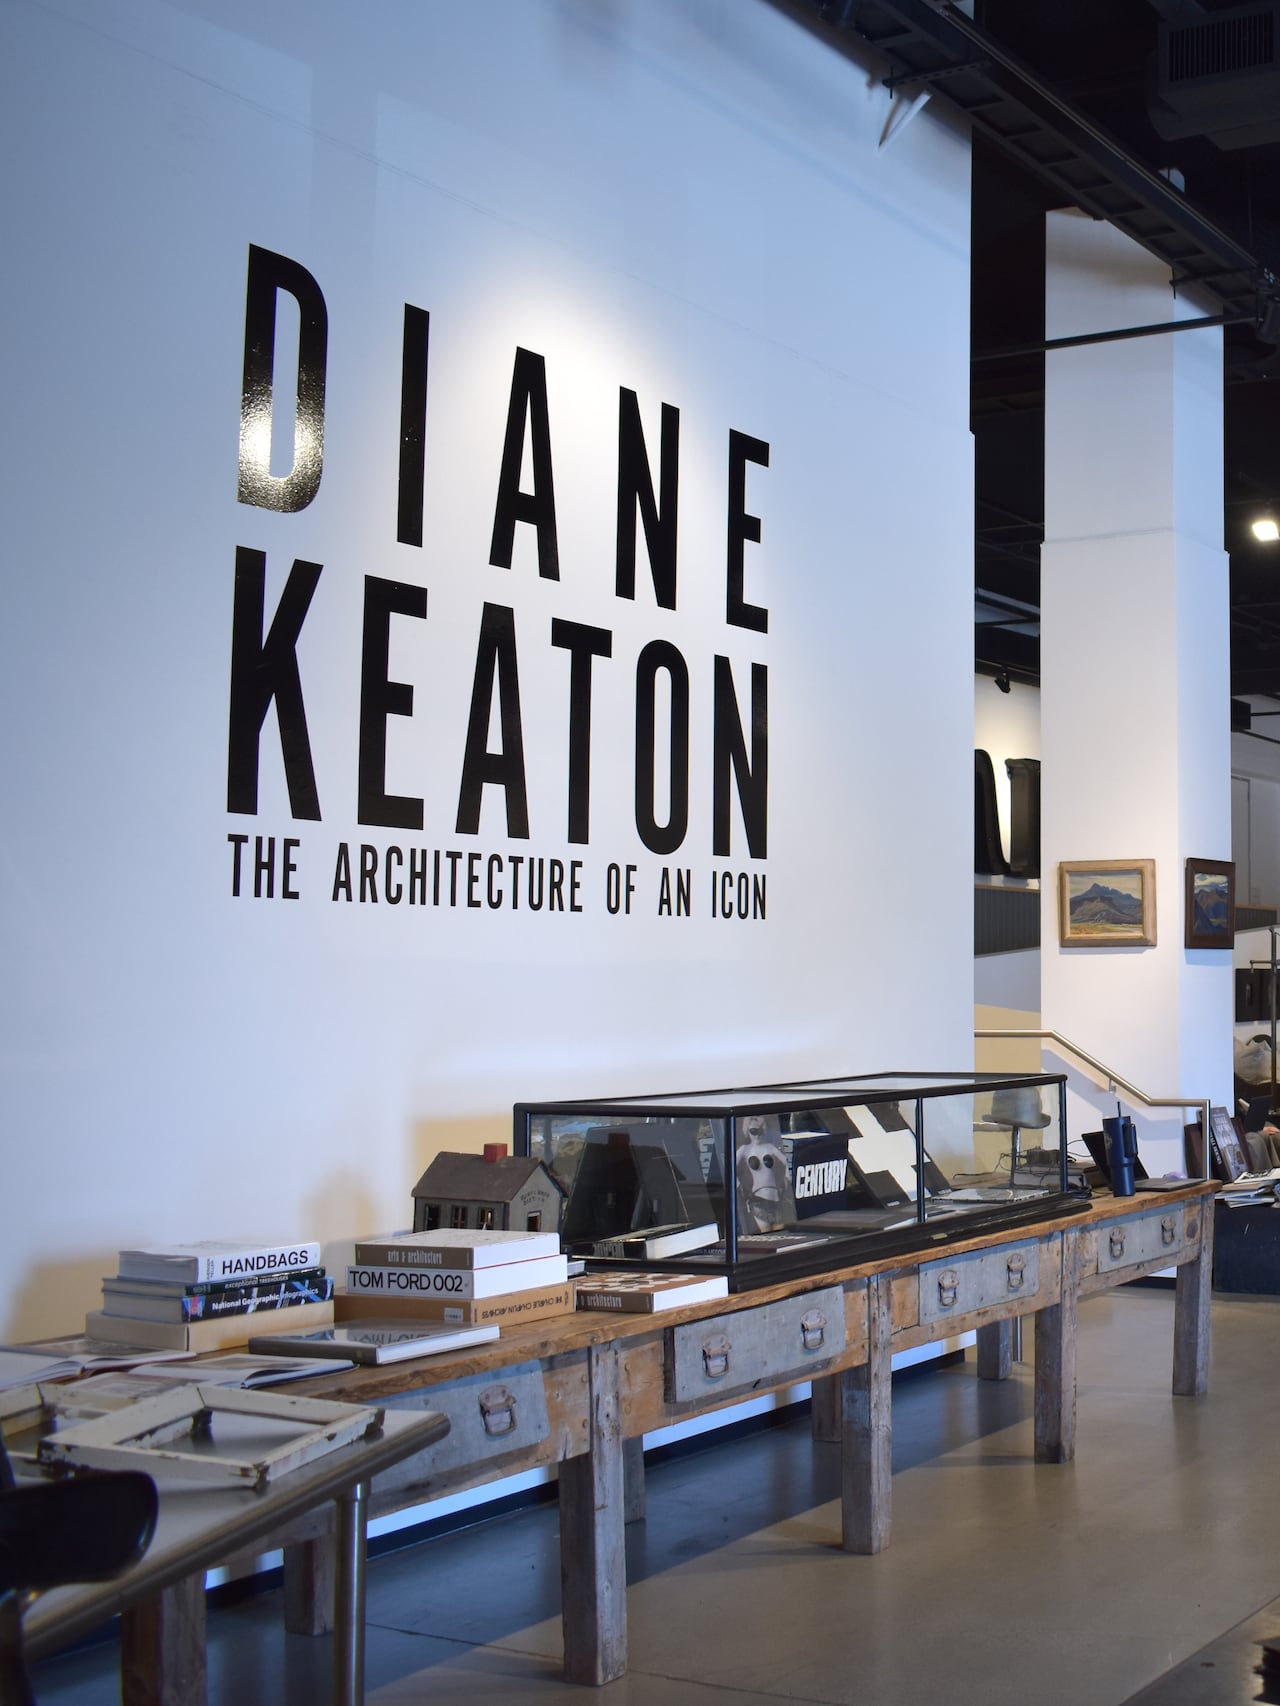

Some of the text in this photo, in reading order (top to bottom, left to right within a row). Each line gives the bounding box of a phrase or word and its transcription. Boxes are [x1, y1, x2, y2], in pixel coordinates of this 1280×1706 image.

[237, 242, 770, 635] DIANE
[227, 544, 768, 859] KEATON
[227, 833, 767, 920] THE ARCHITECTURE OF AN ICON
[795, 1158, 848, 1200] CENTURY
[222, 1250, 309, 1275] HANDBAGS
[349, 1270, 464, 1292] TOM FORD 002
[212, 1298, 241, 1310] National
[242, 1293, 279, 1307] Geographic
